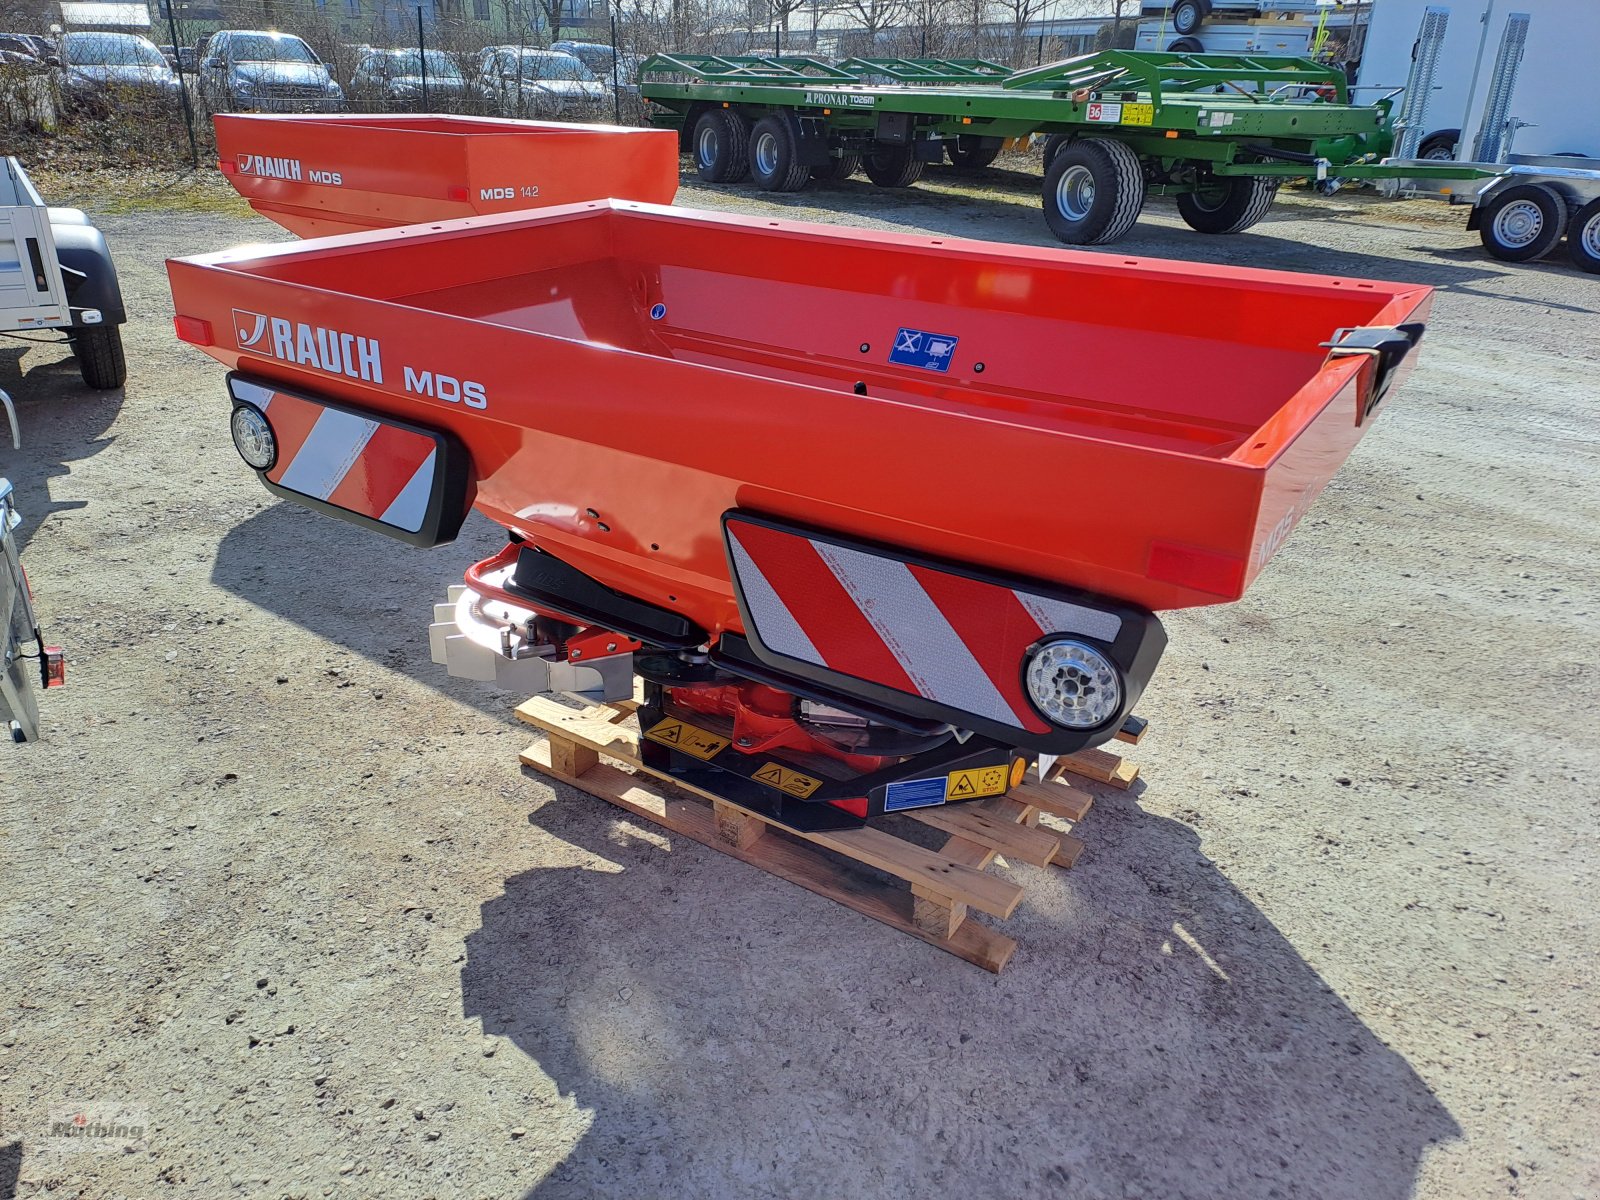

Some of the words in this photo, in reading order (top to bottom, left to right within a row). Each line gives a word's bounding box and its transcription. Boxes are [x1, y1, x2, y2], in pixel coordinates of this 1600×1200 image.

[813, 92, 848, 106] PRONAR
[1089, 106, 1101, 119] 36
[254, 155, 302, 180] RAUCH
[308, 170, 342, 185] MDS
[480, 187, 515, 200] MDS
[270, 316, 384, 385] RAUCH
[403, 366, 488, 410] MDS
